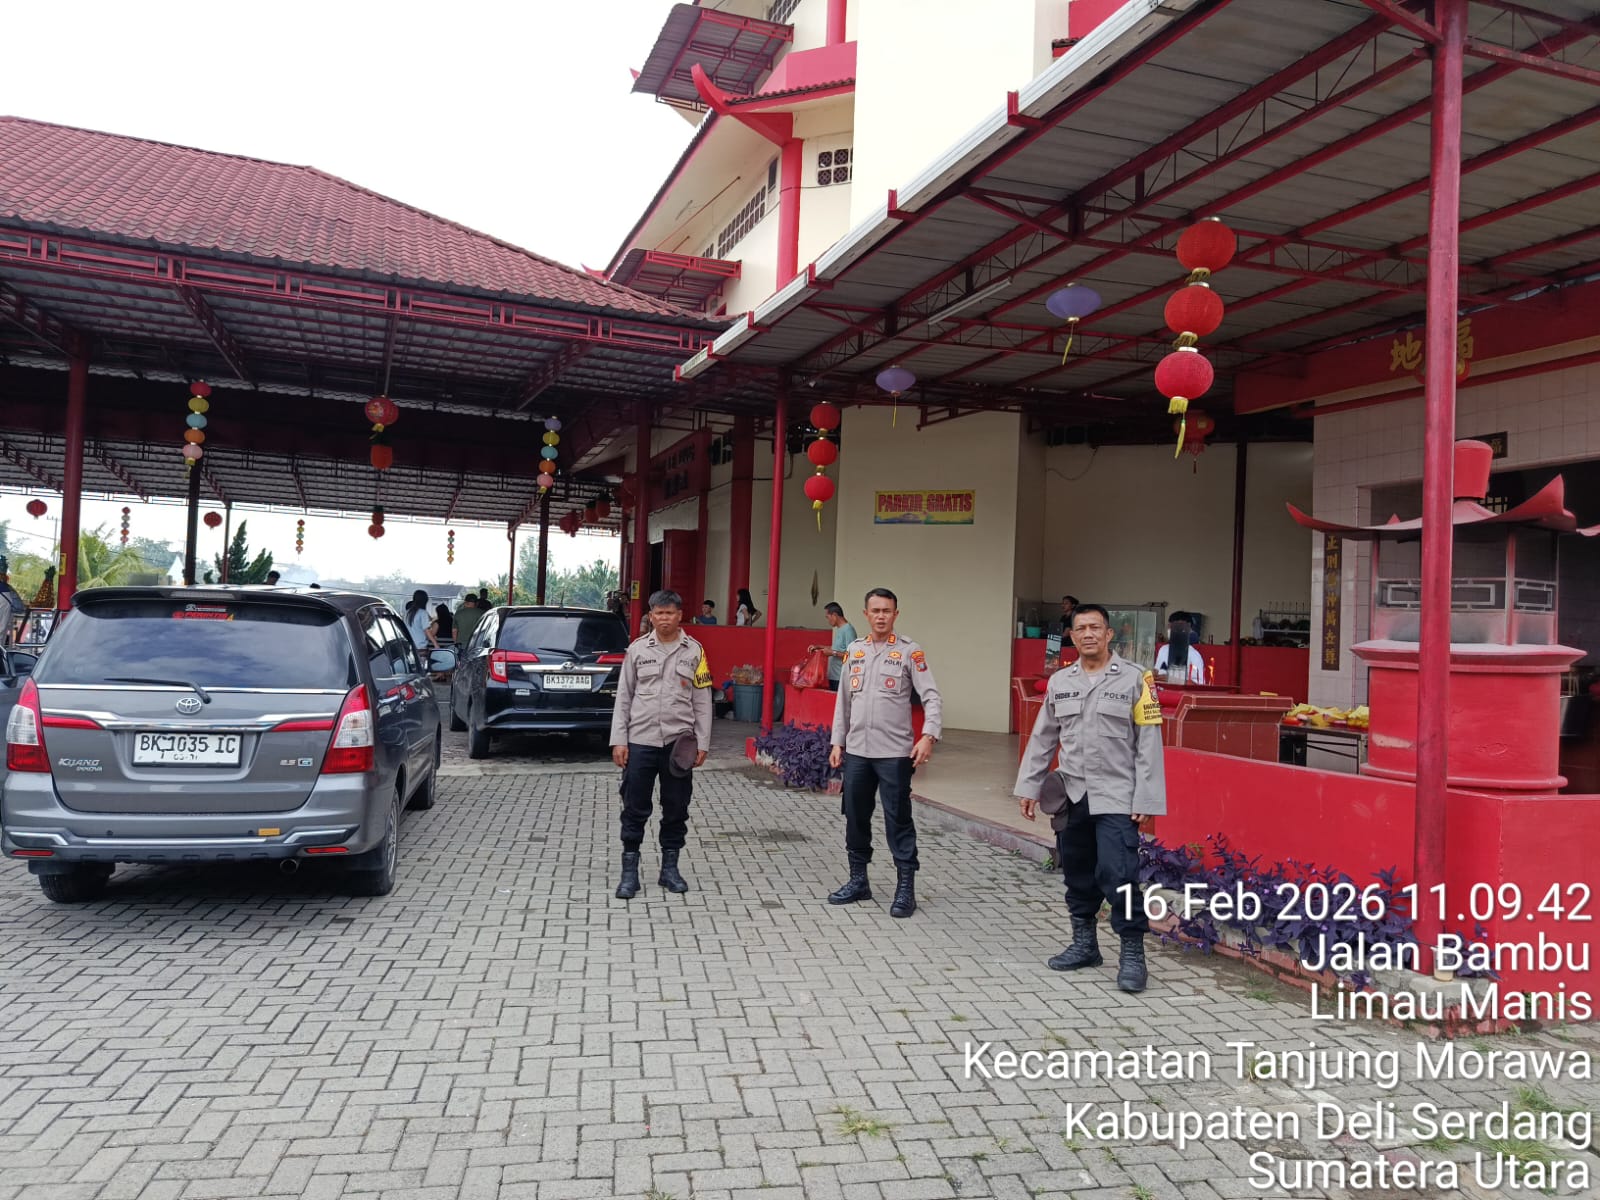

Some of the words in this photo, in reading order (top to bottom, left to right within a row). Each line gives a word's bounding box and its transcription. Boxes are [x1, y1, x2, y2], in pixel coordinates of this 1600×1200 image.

[878, 494, 922, 512] PARKIR
[927, 494, 972, 512] GRATIS
[1104, 691, 1129, 700] POLRI
[140, 735, 161, 751] BK
[168, 736, 209, 753] 1035
[215, 737, 236, 753] IC
